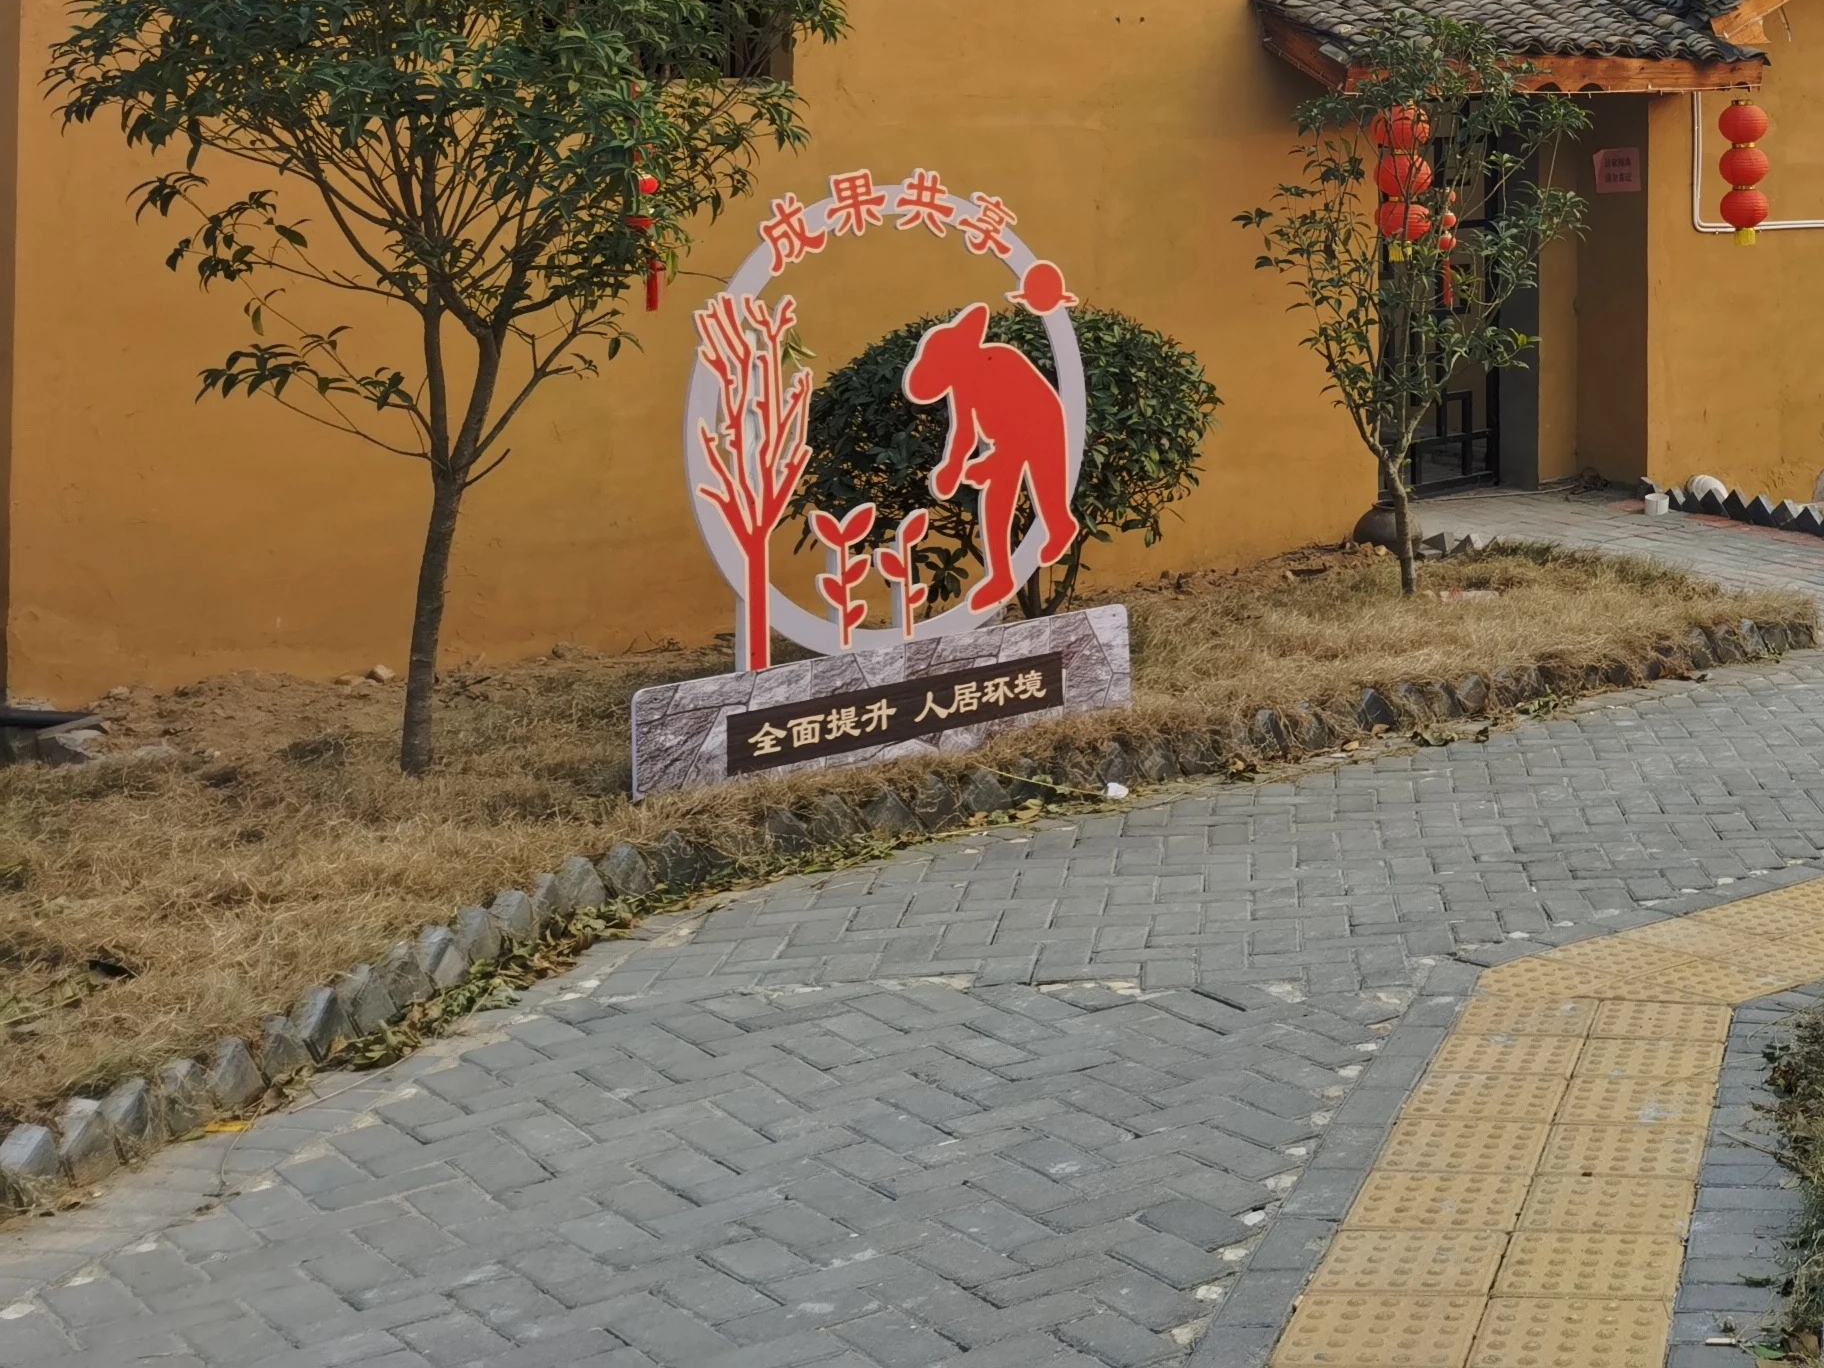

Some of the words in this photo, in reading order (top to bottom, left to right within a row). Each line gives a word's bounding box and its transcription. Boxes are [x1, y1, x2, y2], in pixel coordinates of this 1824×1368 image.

[759, 168, 1018, 275] 成果共享
[747, 698, 898, 757] 全面提升
[913, 669, 1048, 723] 人居环境
